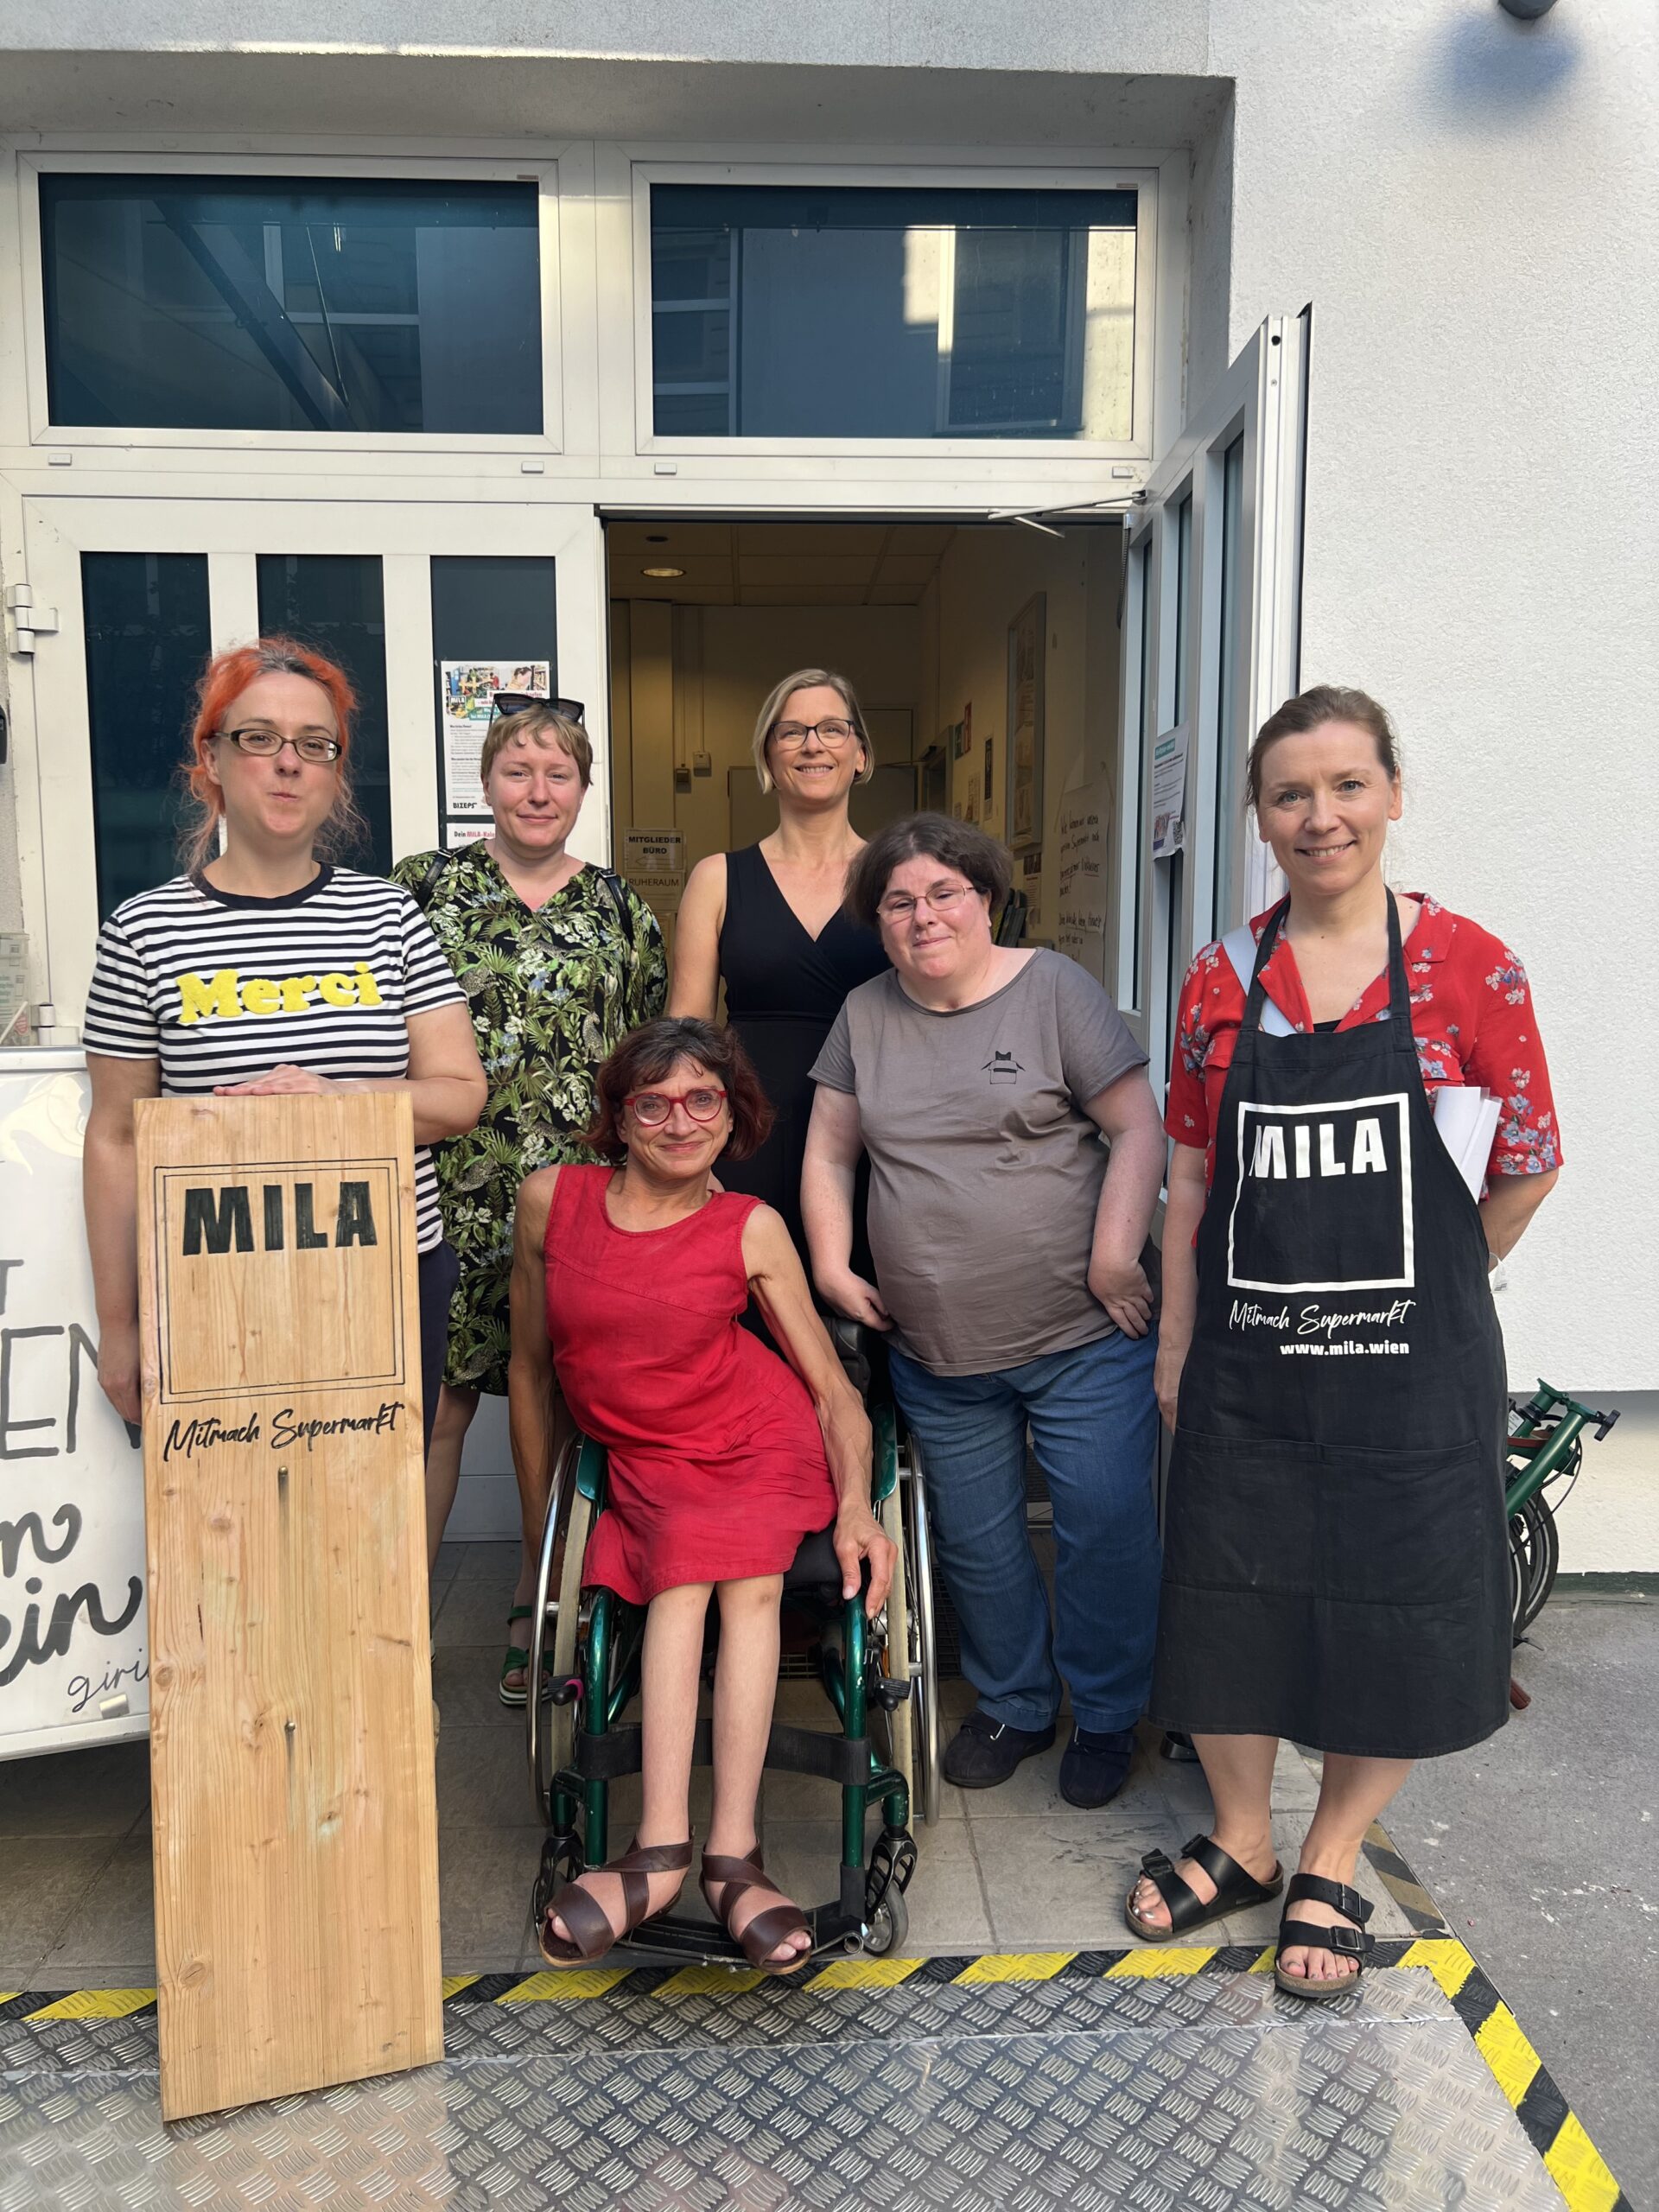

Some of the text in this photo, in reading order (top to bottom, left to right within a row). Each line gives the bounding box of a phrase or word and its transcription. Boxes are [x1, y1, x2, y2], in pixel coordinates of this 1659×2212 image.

[628, 836, 681, 844] MITGLIEDER
[628, 878, 679, 887] RUHERAUM
[175, 961, 384, 1025] Merci
[1249, 1117, 1388, 1179] MILA
[182, 1180, 378, 1255] MILA
[1229, 1299, 1416, 1339] Mitmach Supermarkt
[1280, 1340, 1410, 1356] www.mila.wien
[163, 1401, 405, 1462] Mitmach Supermarkt
